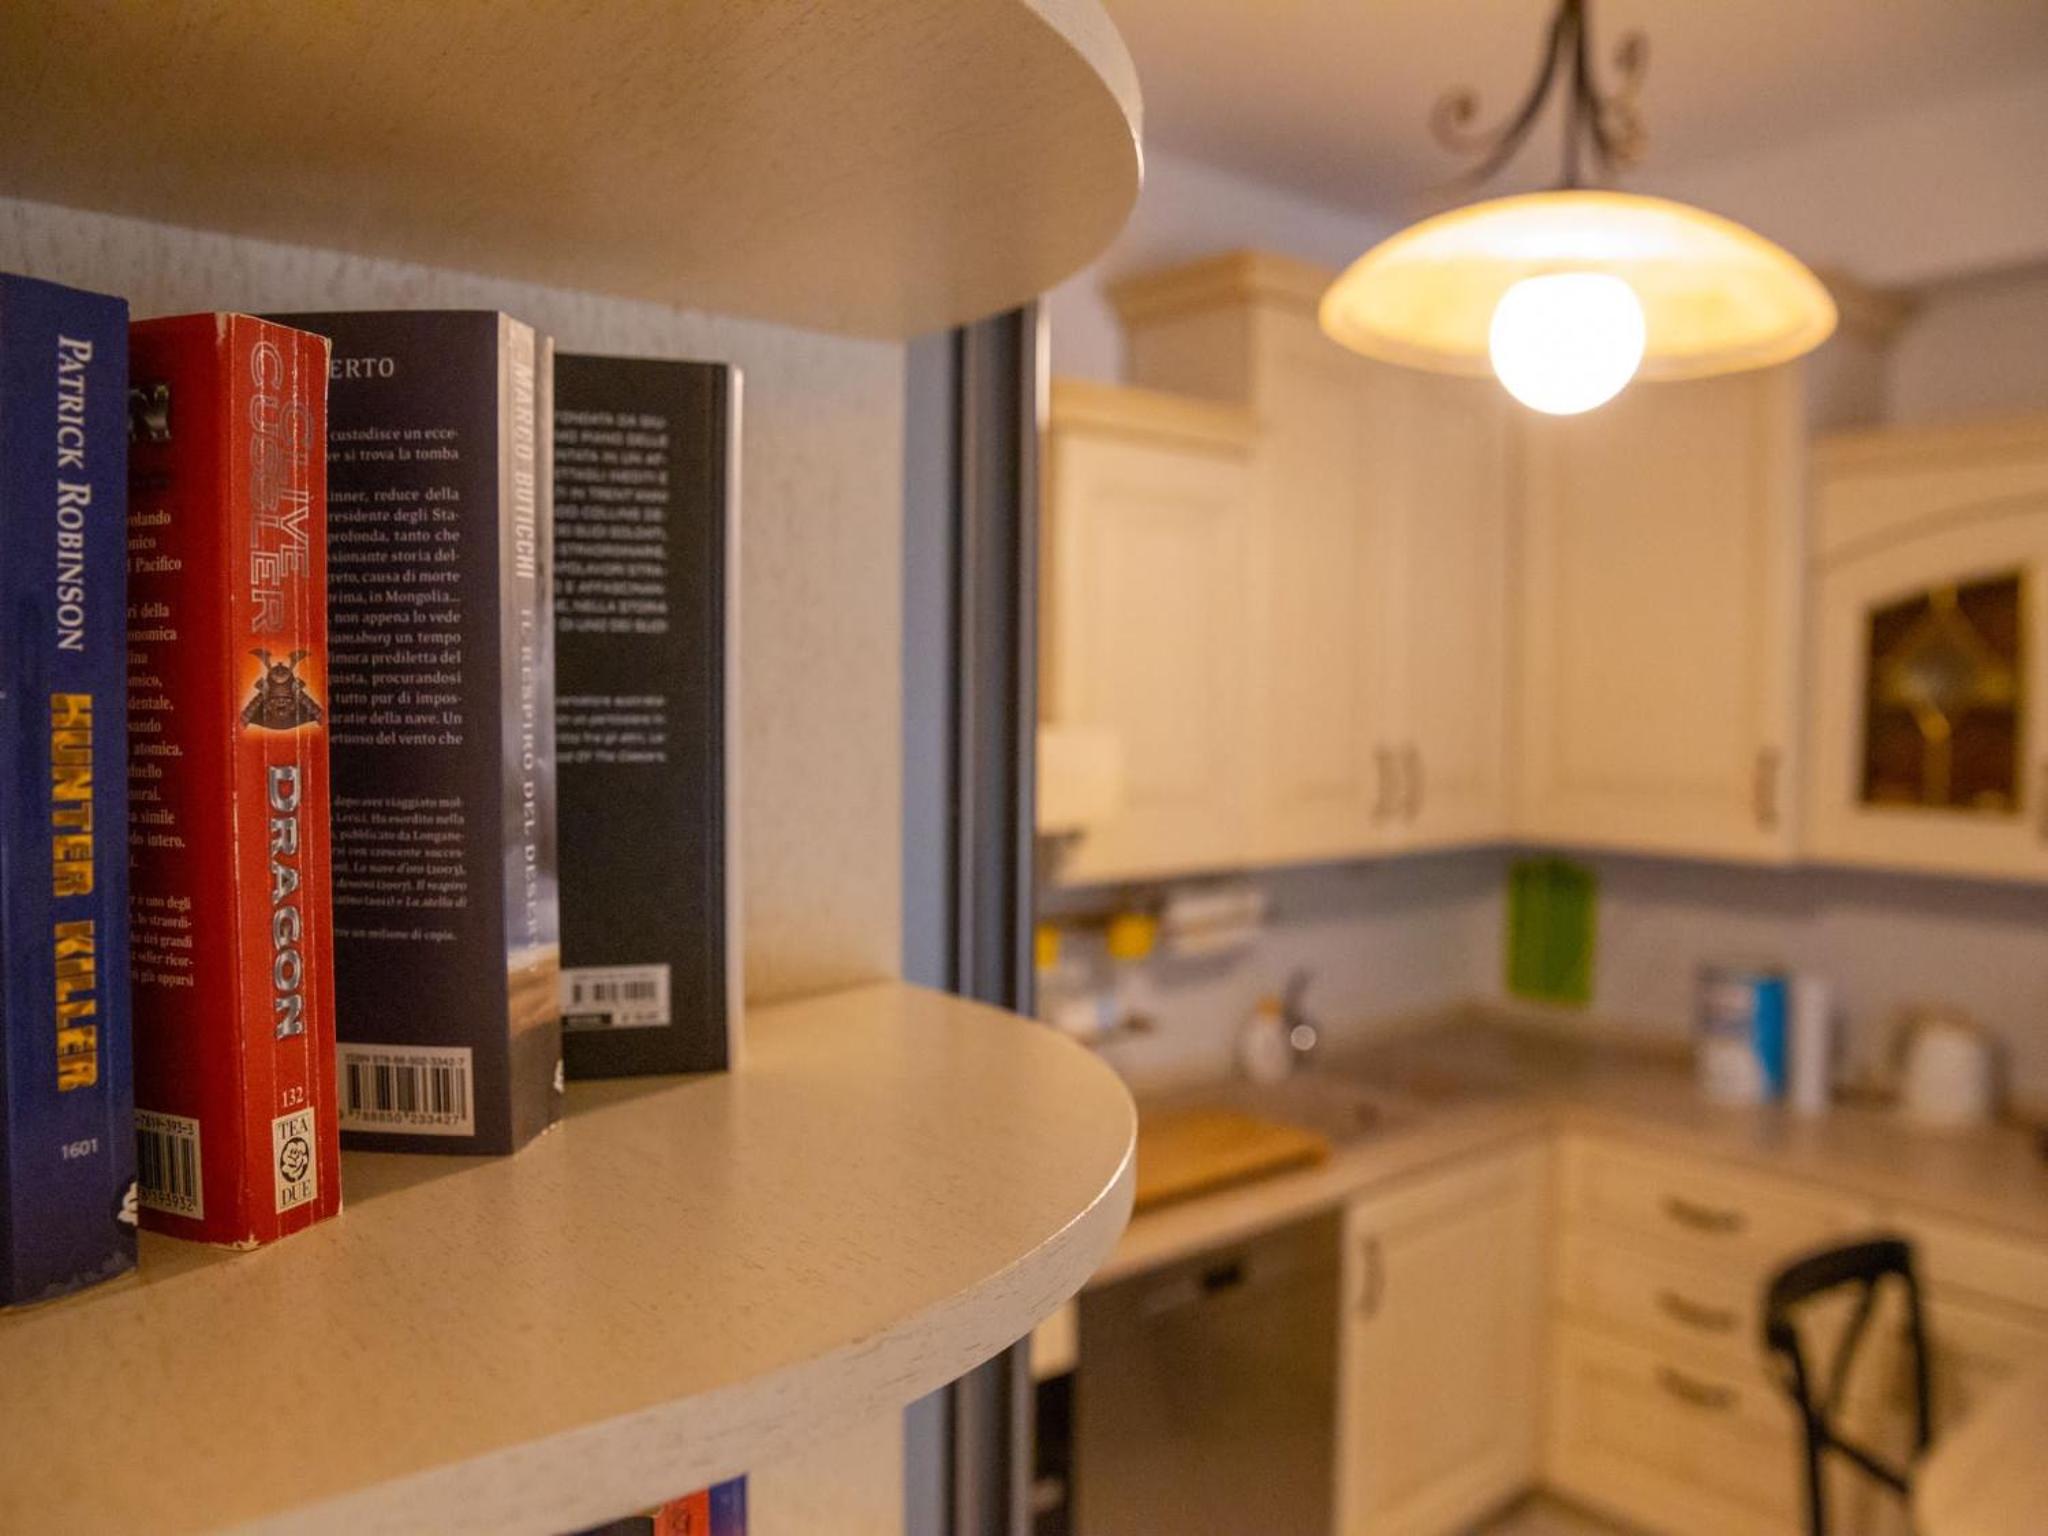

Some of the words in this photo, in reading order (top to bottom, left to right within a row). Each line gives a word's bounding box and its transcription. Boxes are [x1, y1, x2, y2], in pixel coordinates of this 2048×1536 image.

[58, 334, 93, 470] PATRICK
[513, 361, 535, 460] MARCO
[330, 426, 400, 441] custodisce
[403, 428, 422, 441] un
[424, 427, 459, 441] ecce-
[344, 446, 356, 461] si
[359, 447, 396, 461] trova
[398, 446, 412, 461] la
[415, 446, 460, 461] tomba
[249, 339, 285, 633] CUSSLER
[374, 486, 420, 501] reduce
[425, 485, 460, 501] della
[393, 506, 428, 526] degli
[432, 507, 461, 521] Sta-
[514, 470, 535, 580] BUTICCHI
[394, 529, 431, 542] tanto
[434, 526, 461, 542] che
[391, 549, 432, 562] storia
[434, 547, 461, 562] del-
[57, 480, 92, 651] ROBINSON
[136, 556, 183, 573] Pacifico
[361, 571, 401, 583] causa
[402, 568, 417, 583] di
[418, 571, 462, 583] morte
[369, 590, 383, 603] in
[140, 601, 171, 619] della
[335, 611, 360, 624] non
[361, 612, 410, 627] appena
[413, 609, 428, 623] lo
[428, 608, 462, 623] vede
[394, 632, 414, 644] un
[416, 632, 463, 647] tempo
[371, 650, 437, 668] prediletta
[440, 649, 462, 664] del
[371, 669, 462, 688] procurandosi
[370, 692, 396, 710] pur
[397, 689, 411, 704] di
[415, 690, 462, 710] impos-
[369, 710, 402, 725] della
[404, 712, 440, 725] nave.
[442, 710, 463, 726] Un
[375, 730, 397, 746] del
[398, 732, 437, 746] vento
[438, 730, 464, 746] che
[134, 740, 184, 756] atomica.
[50, 694, 93, 897] HUNTER
[141, 808, 176, 825] simile
[522, 780, 536, 837] DEL
[436, 812, 466, 825] nella
[147, 832, 187, 849] intero.
[167, 894, 192, 913] degli
[269, 764, 303, 1041] DRAGON
[54, 920, 98, 1092] KILLER
[281, 1086, 304, 1109] 132
[277, 1117, 309, 1141] TEA
[61, 1137, 99, 1160] 1601
[281, 1179, 313, 1208] DUE
